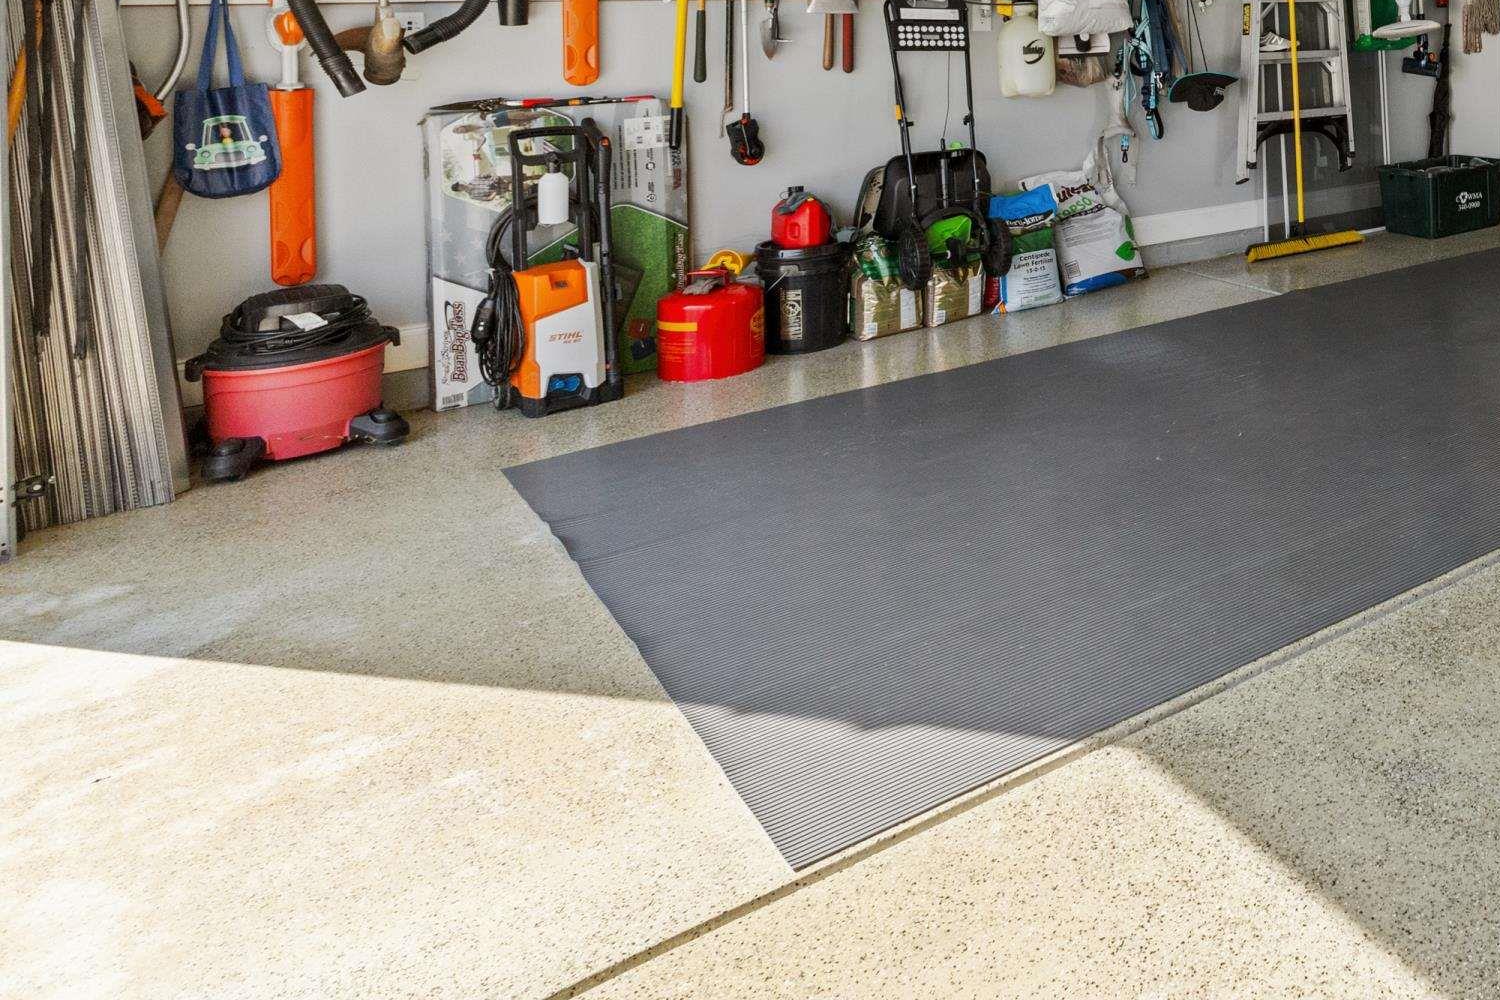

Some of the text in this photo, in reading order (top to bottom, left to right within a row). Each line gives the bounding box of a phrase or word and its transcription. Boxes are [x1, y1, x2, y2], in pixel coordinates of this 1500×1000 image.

[1019, 251, 1051, 262] Centipede
[1013, 261, 1030, 271] Lawn
[450, 302, 464, 331] Toss
[548, 331, 583, 342] STIHL
[451, 354, 466, 381] Bean
